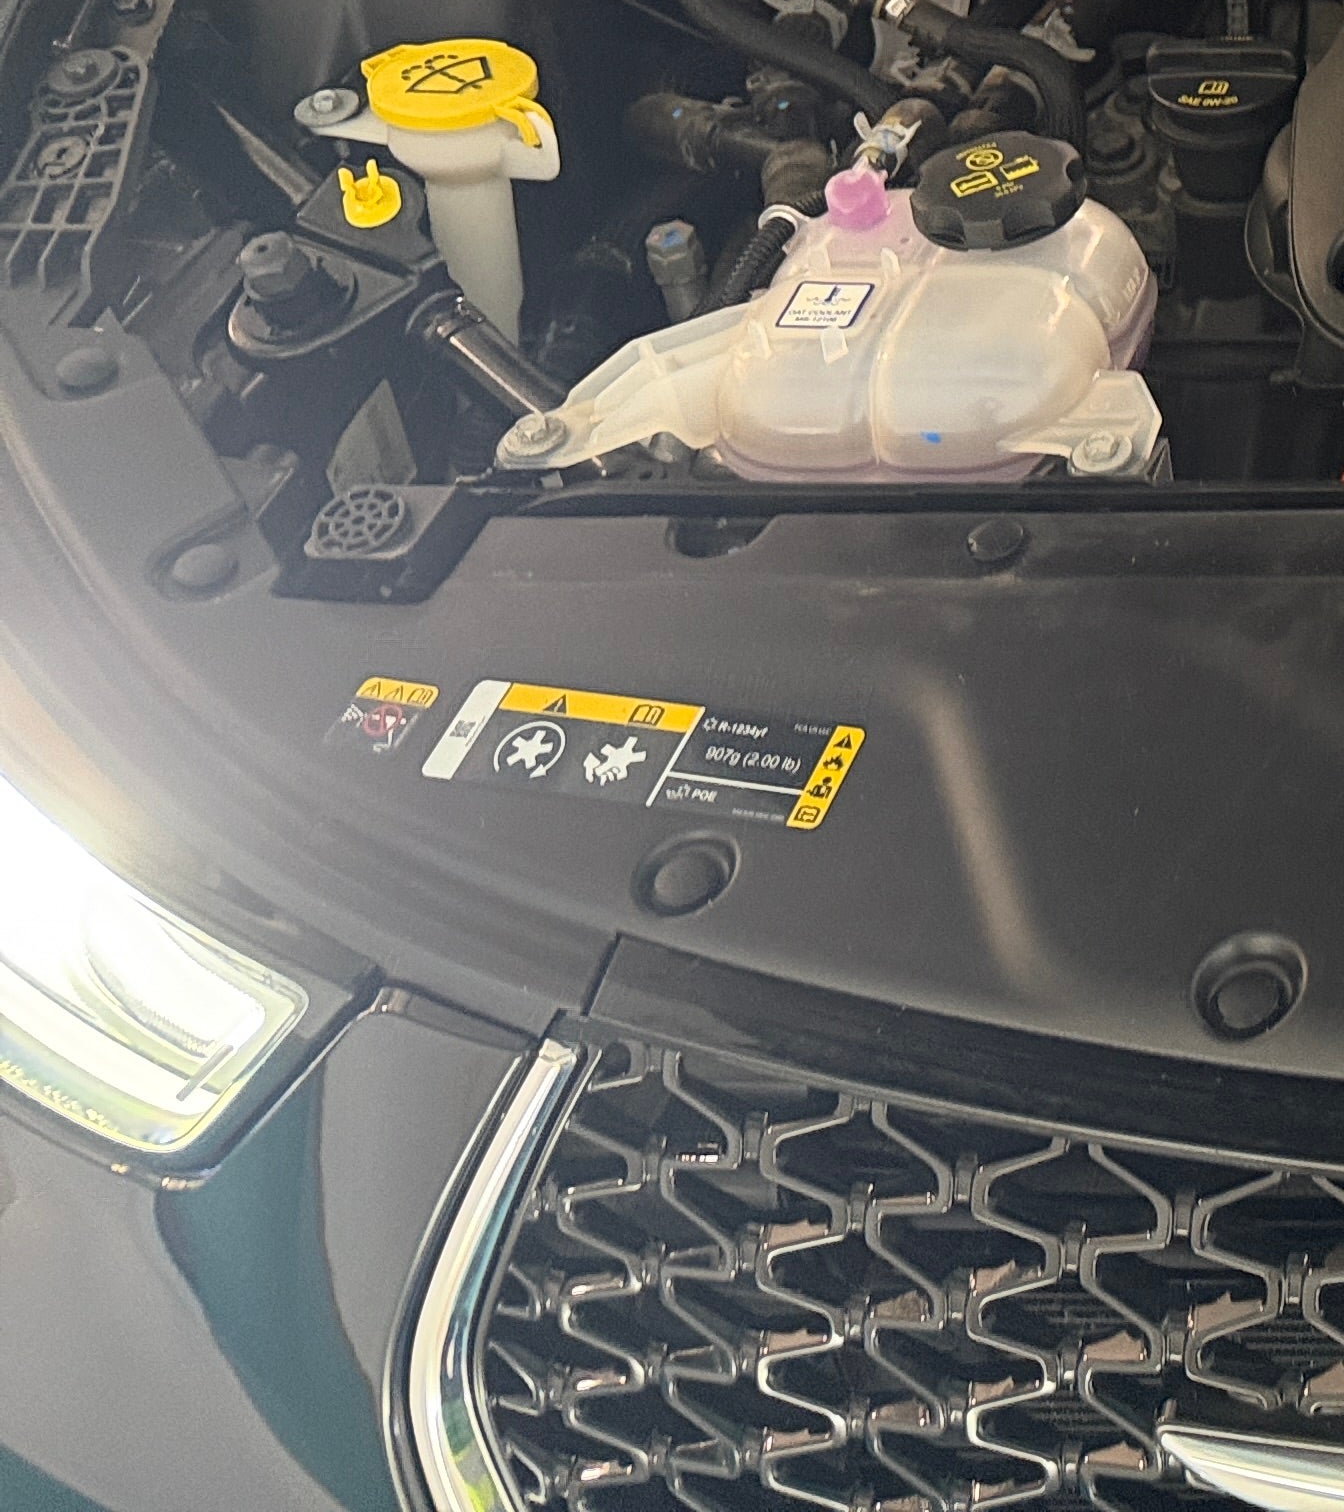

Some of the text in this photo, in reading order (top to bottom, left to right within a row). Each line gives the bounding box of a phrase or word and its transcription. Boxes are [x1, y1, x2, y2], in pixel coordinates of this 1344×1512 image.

[705, 745, 801, 775] 907g (2.00 lb)
